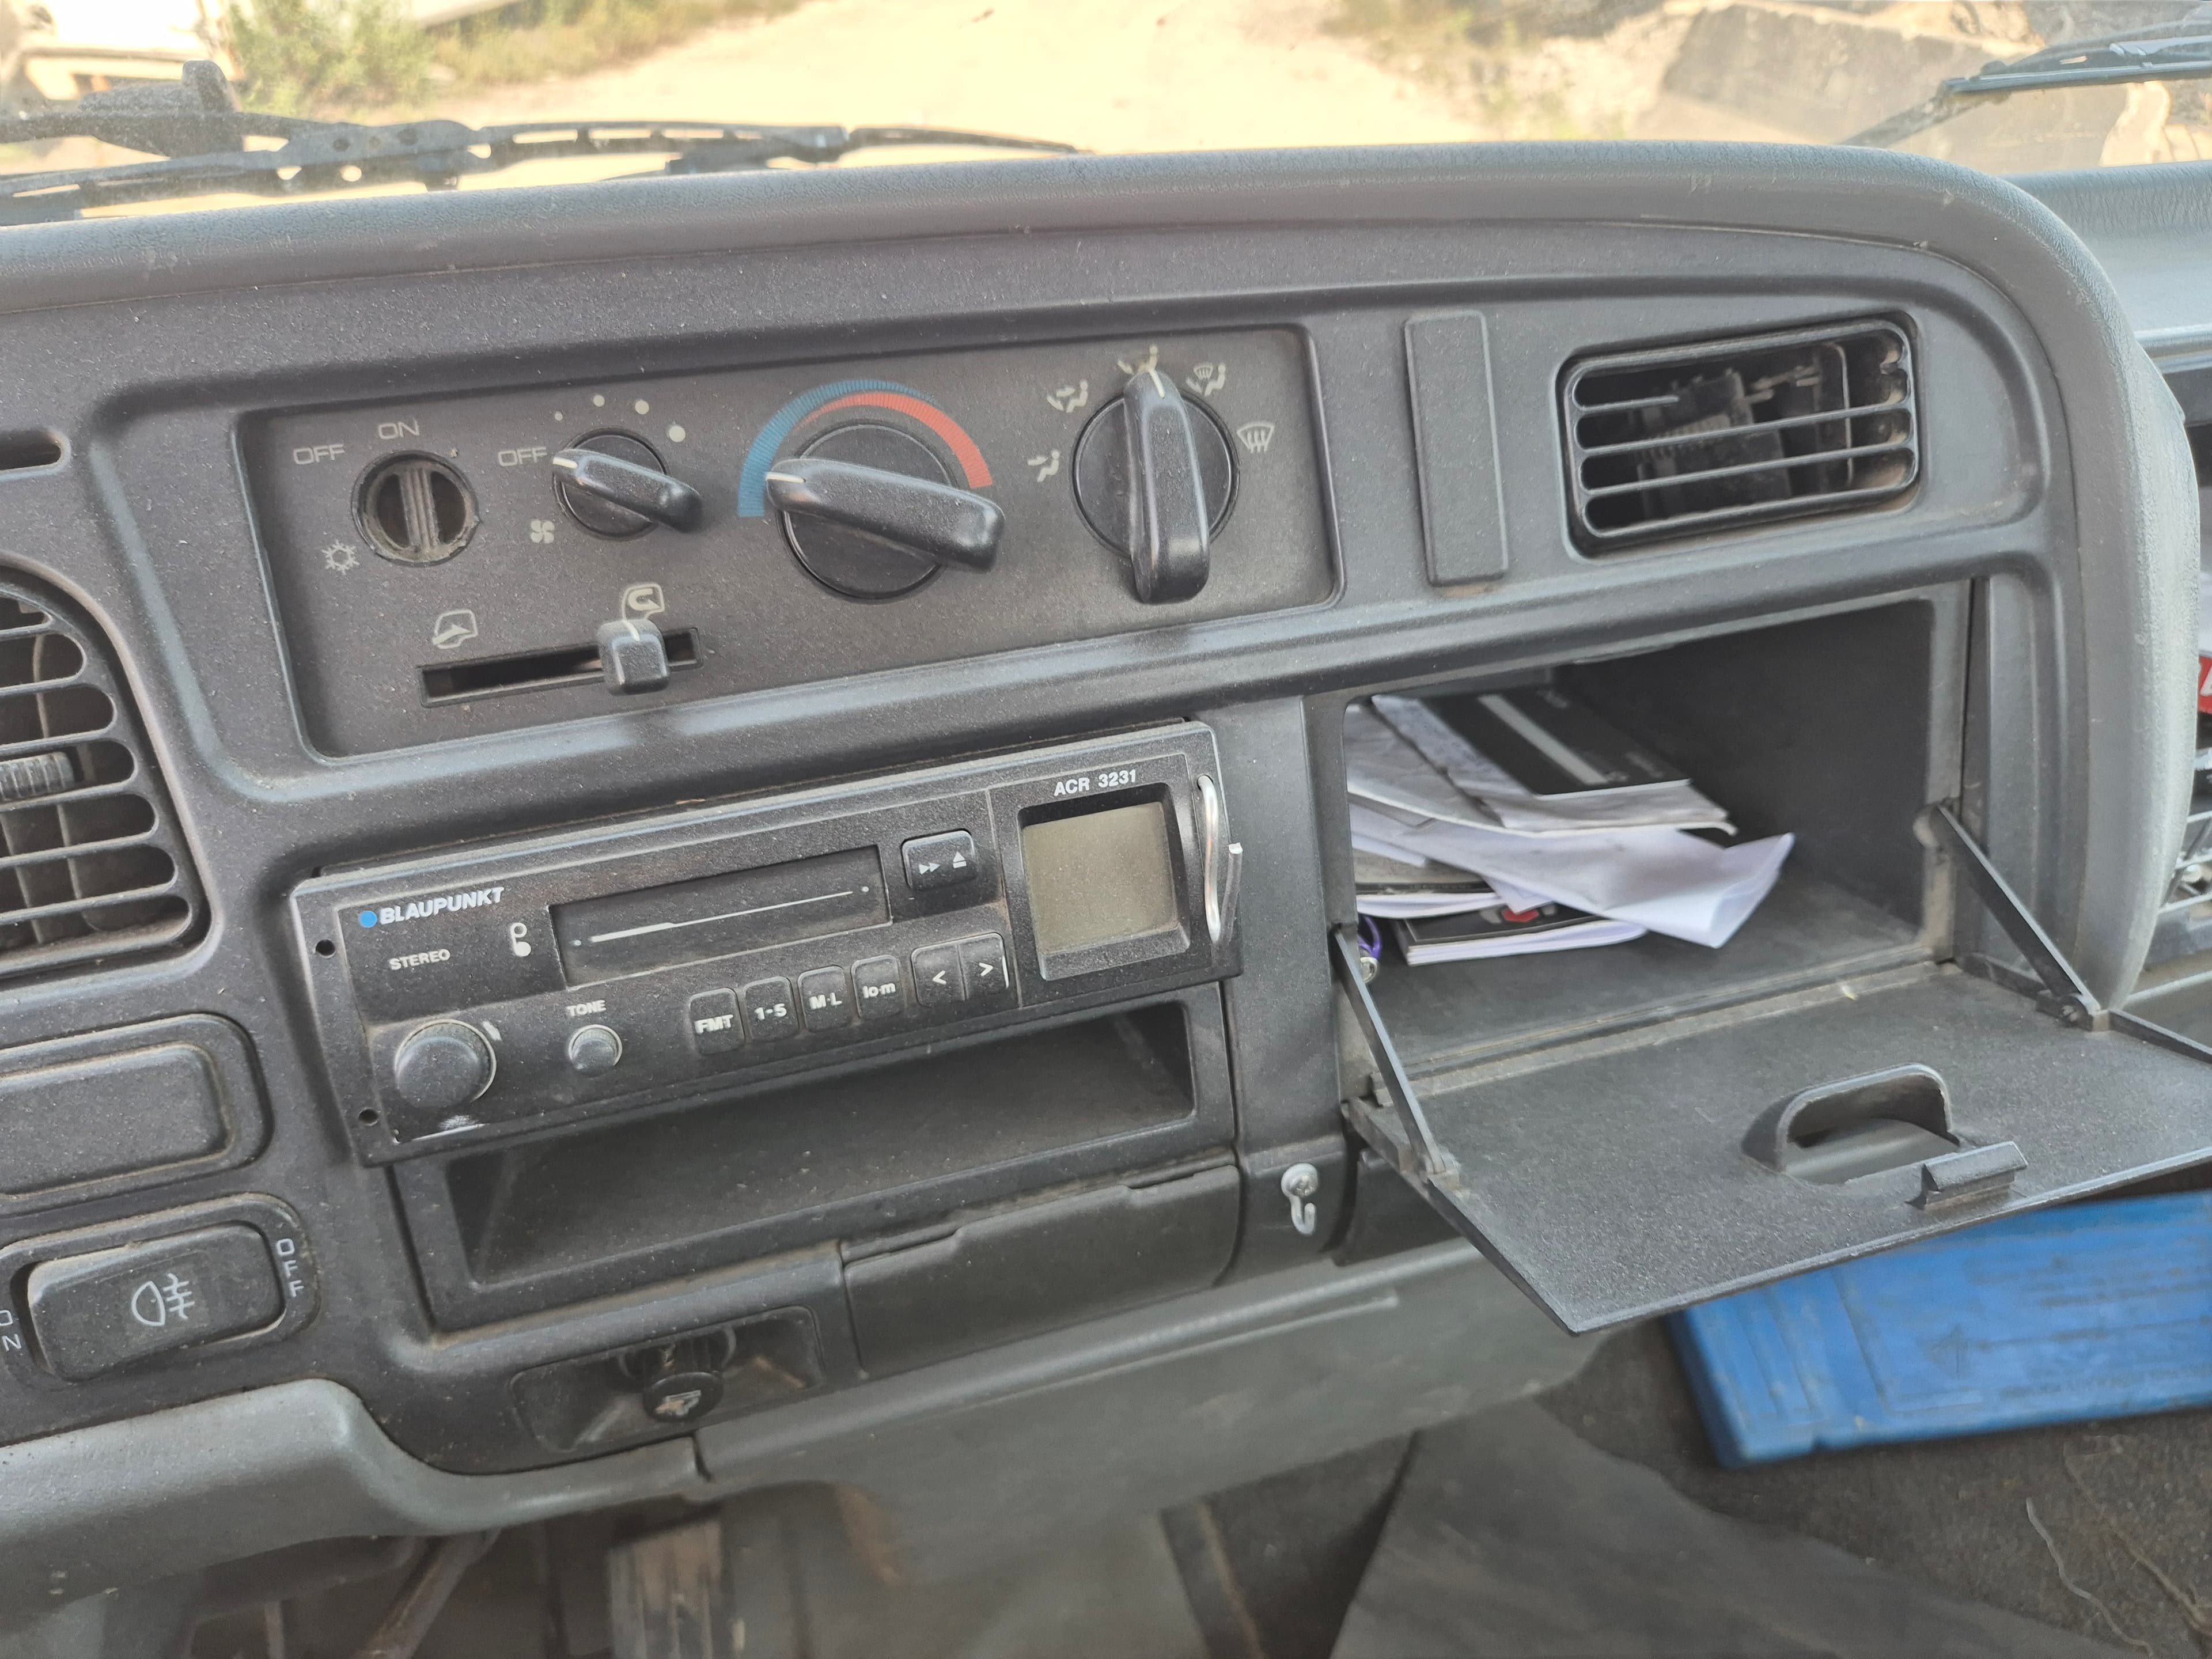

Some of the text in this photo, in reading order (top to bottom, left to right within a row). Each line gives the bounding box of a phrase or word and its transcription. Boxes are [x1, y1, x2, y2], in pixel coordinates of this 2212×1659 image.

[378, 421, 419, 440] ON
[293, 444, 344, 464] OFF
[498, 447, 547, 467] OFF
[1054, 770, 1137, 797] ACR 3231
[379, 887, 505, 925] BLAUPUNKT
[389, 949, 450, 971] STEREO
[567, 1000, 606, 1018] TONE
[755, 1003, 787, 1020] 1-5
[276, 1238, 305, 1297] OFF
